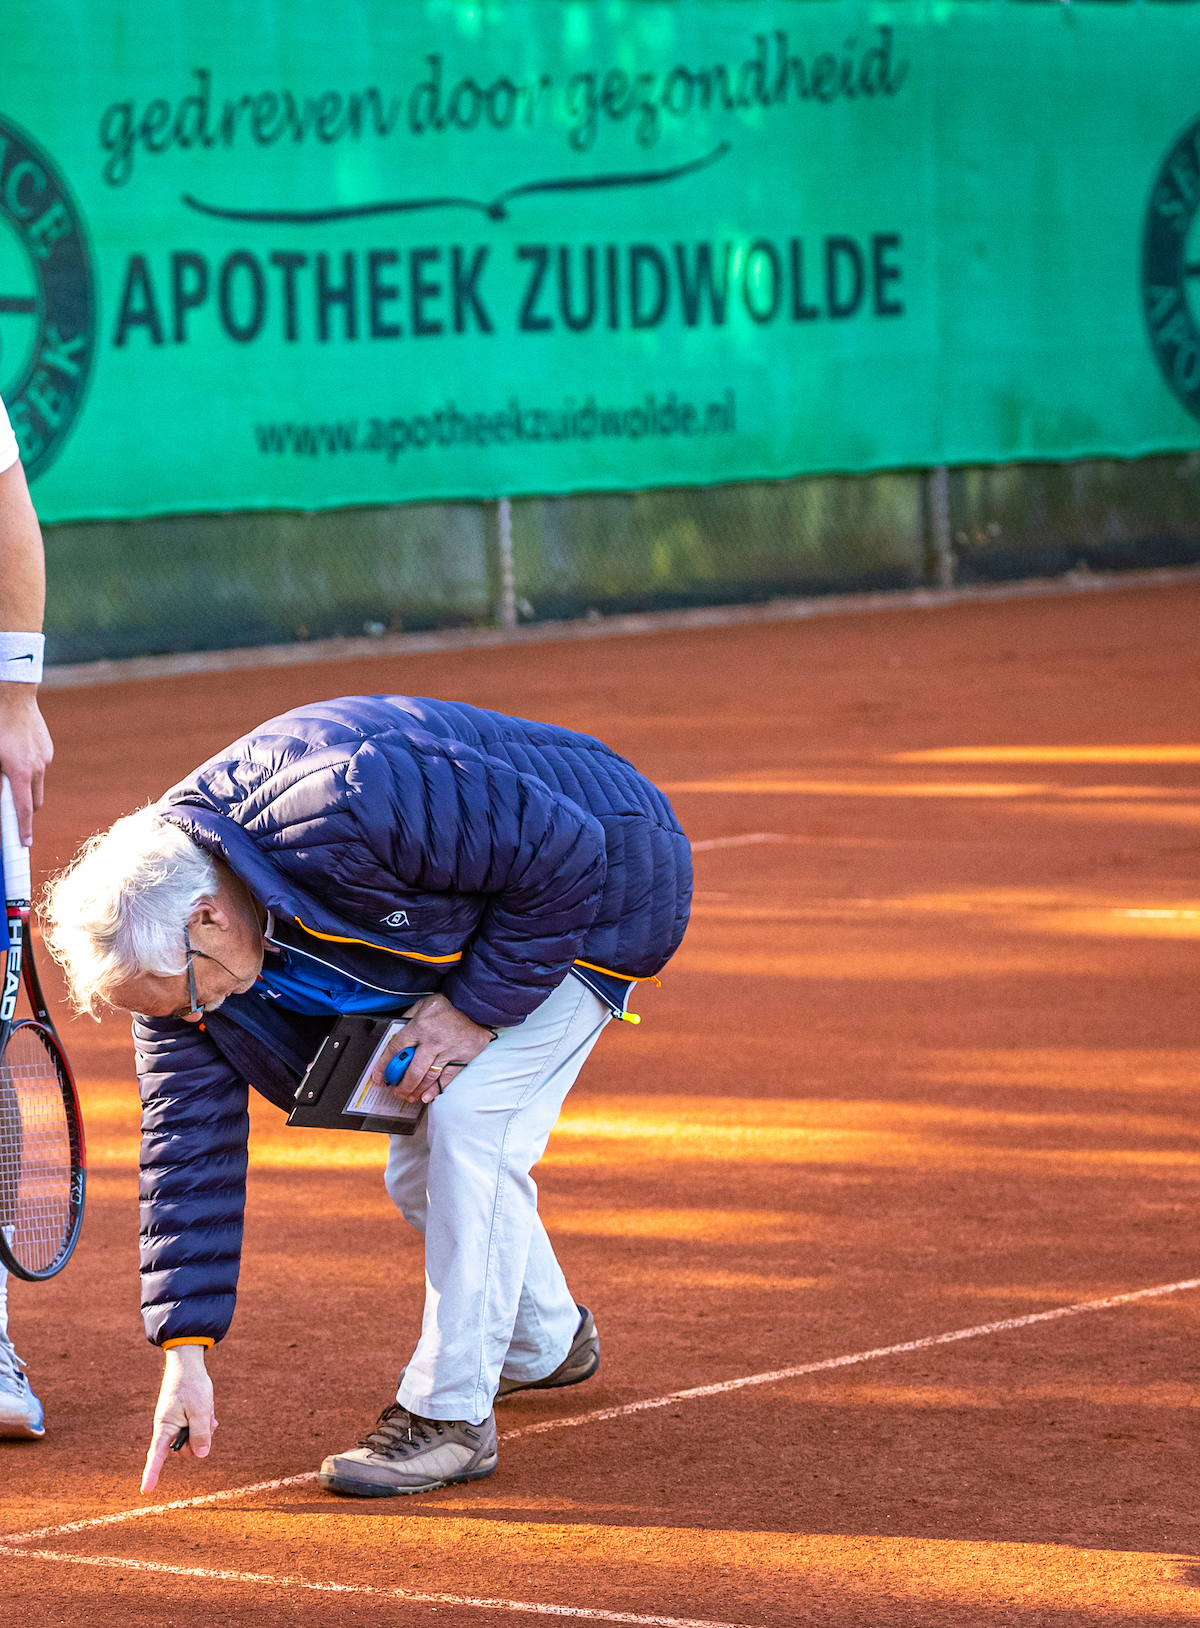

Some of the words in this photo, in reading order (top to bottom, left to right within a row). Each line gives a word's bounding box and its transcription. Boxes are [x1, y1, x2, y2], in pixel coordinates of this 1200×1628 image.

[99, 69, 396, 186] gedreven
[407, 52, 552, 136] door
[566, 24, 911, 153] gezondheid
[112, 243, 497, 348] APOTHEEK
[515, 232, 905, 335] ZUIDWOLDE
[254, 387, 737, 465] www.apotheekzuidwolde.nl
[0, 918, 23, 1022] HEAD
